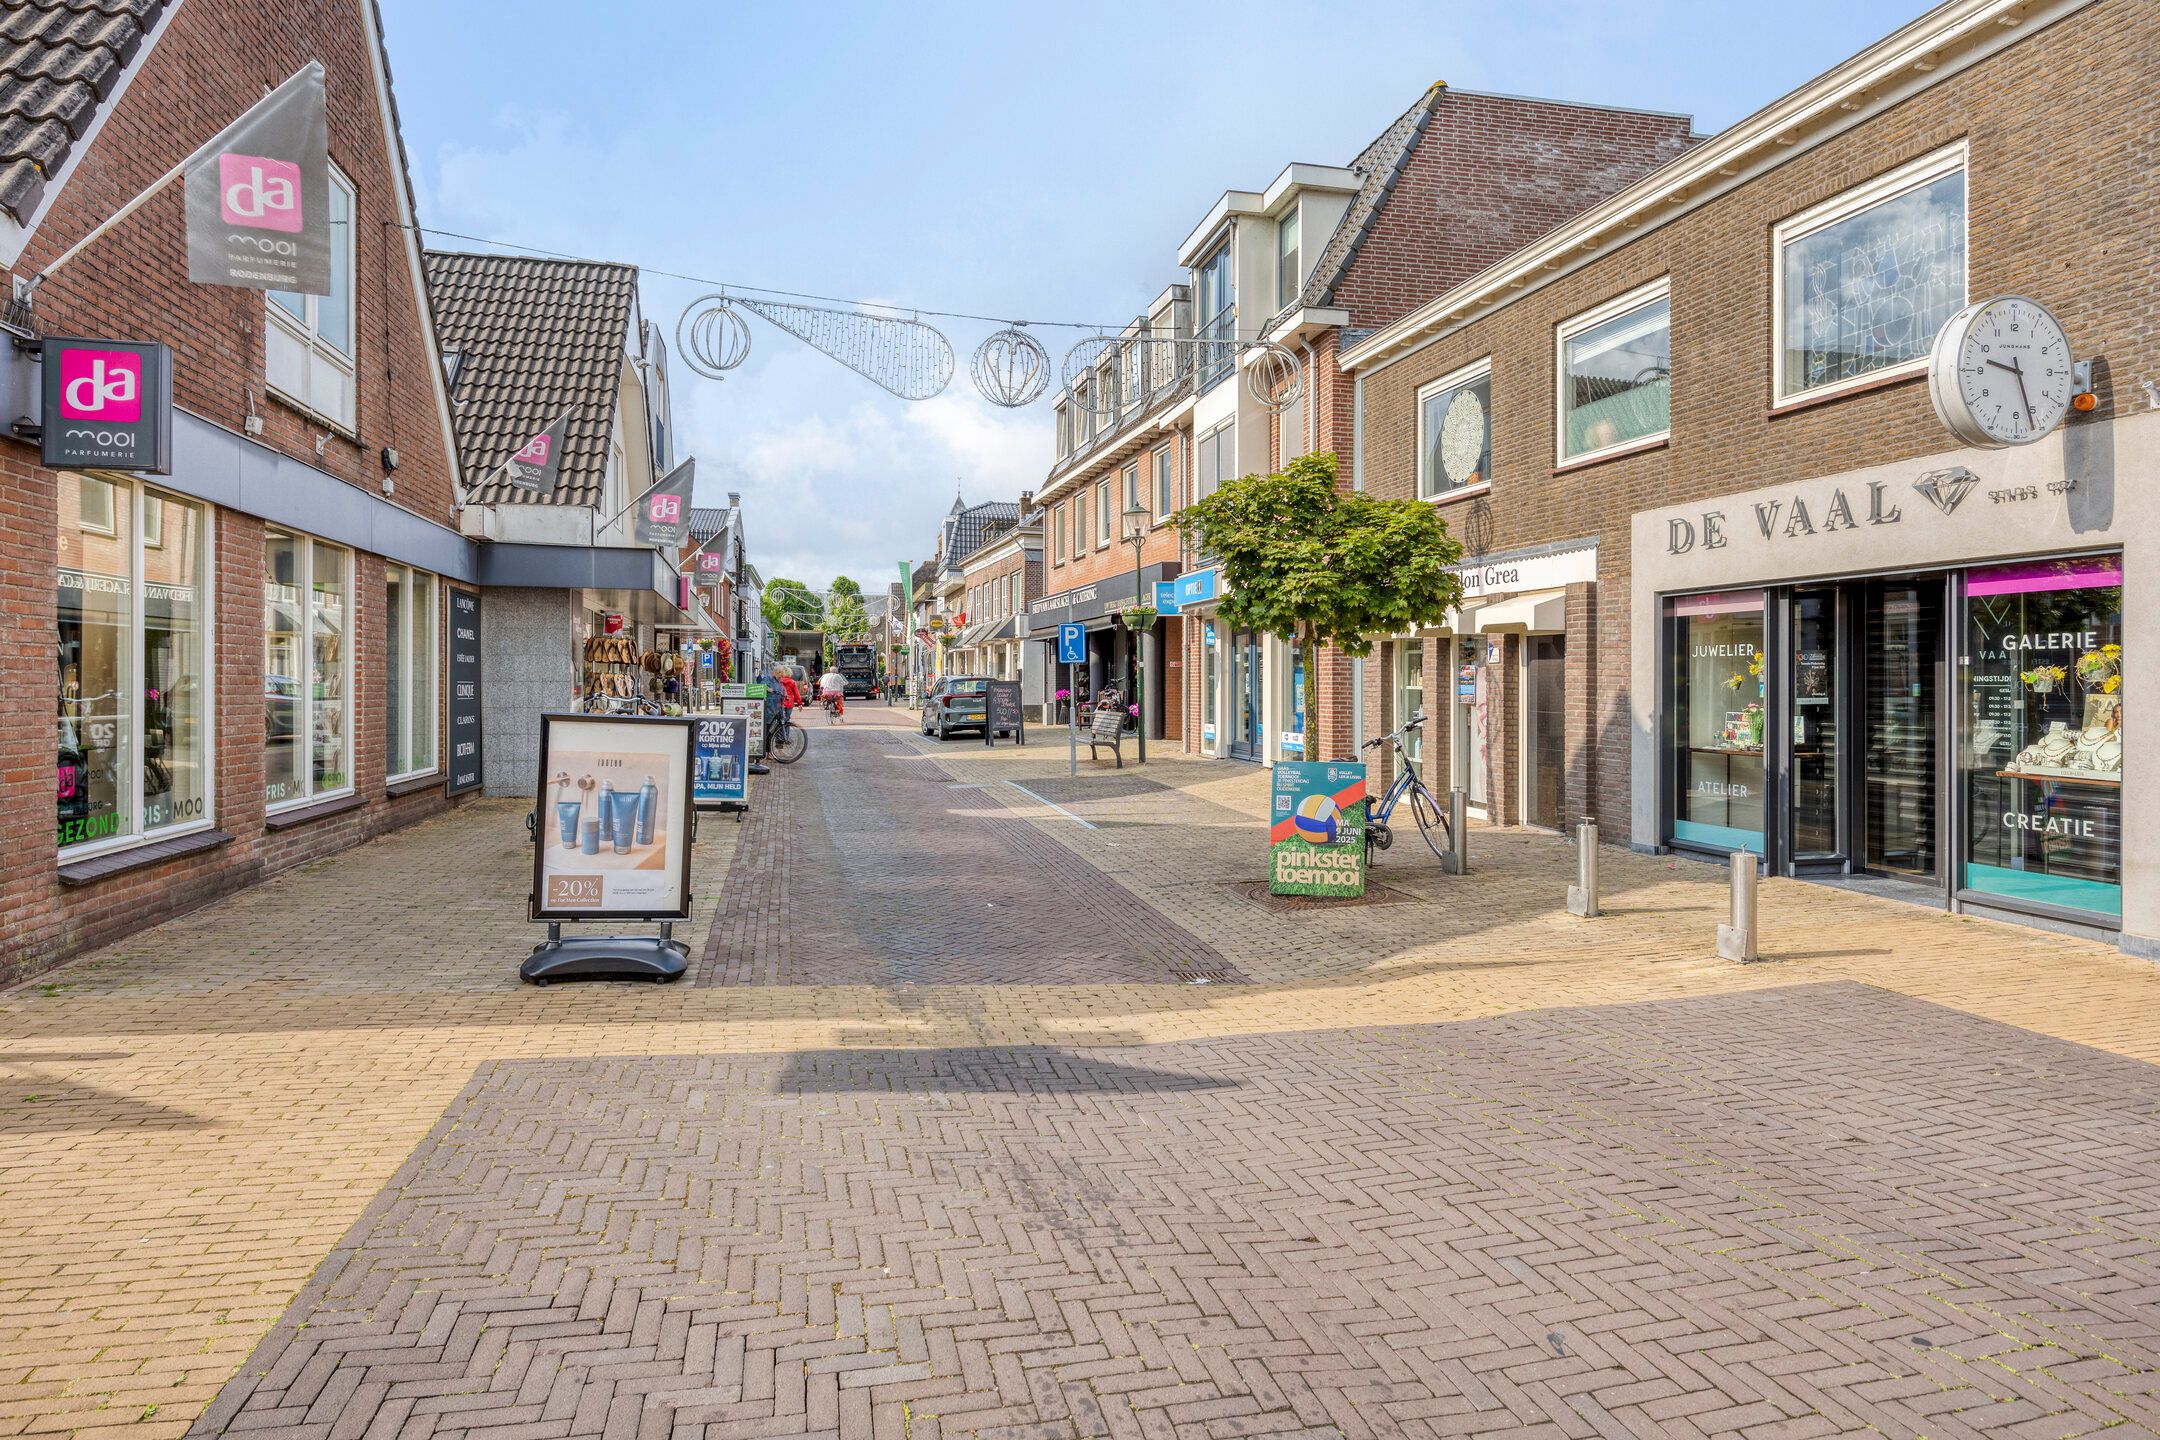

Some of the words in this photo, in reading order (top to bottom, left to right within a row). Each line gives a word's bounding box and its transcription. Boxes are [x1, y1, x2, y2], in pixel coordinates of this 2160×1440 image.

[226, 166, 294, 217] da
[229, 269, 297, 284] RODENBURG
[2010, 323, 2019, 332] 12
[1981, 345, 1990, 353] 10
[65, 359, 135, 412] da
[1982, 389, 1989, 397] 8
[2042, 390, 2049, 398] 4
[1995, 405, 2002, 413] 7
[2013, 411, 2019, 419] 6
[2030, 406, 2036, 414] 5
[65, 449, 135, 458] PARFUMERIE
[652, 498, 678, 518] da
[1665, 510, 1728, 556] DE
[1750, 480, 1903, 541] VAAL
[701, 555, 719, 569] da
[1485, 567, 1519, 586] Grea
[456, 627, 475, 641] CHANEL
[1064, 626, 1079, 646] P
[2002, 632, 2097, 650] GALERIE
[1692, 643, 1754, 658] JUWELIER
[699, 721, 735, 736] 20%
[698, 735, 734, 743] KORTING
[266, 782, 286, 800] FRIS
[1698, 781, 1748, 798] ATELIER
[1335, 819, 1350, 827] MA
[2002, 812, 2095, 838] CREATIE
[1277, 847, 1360, 869] pinkster
[1276, 866, 1360, 886] toernooi
